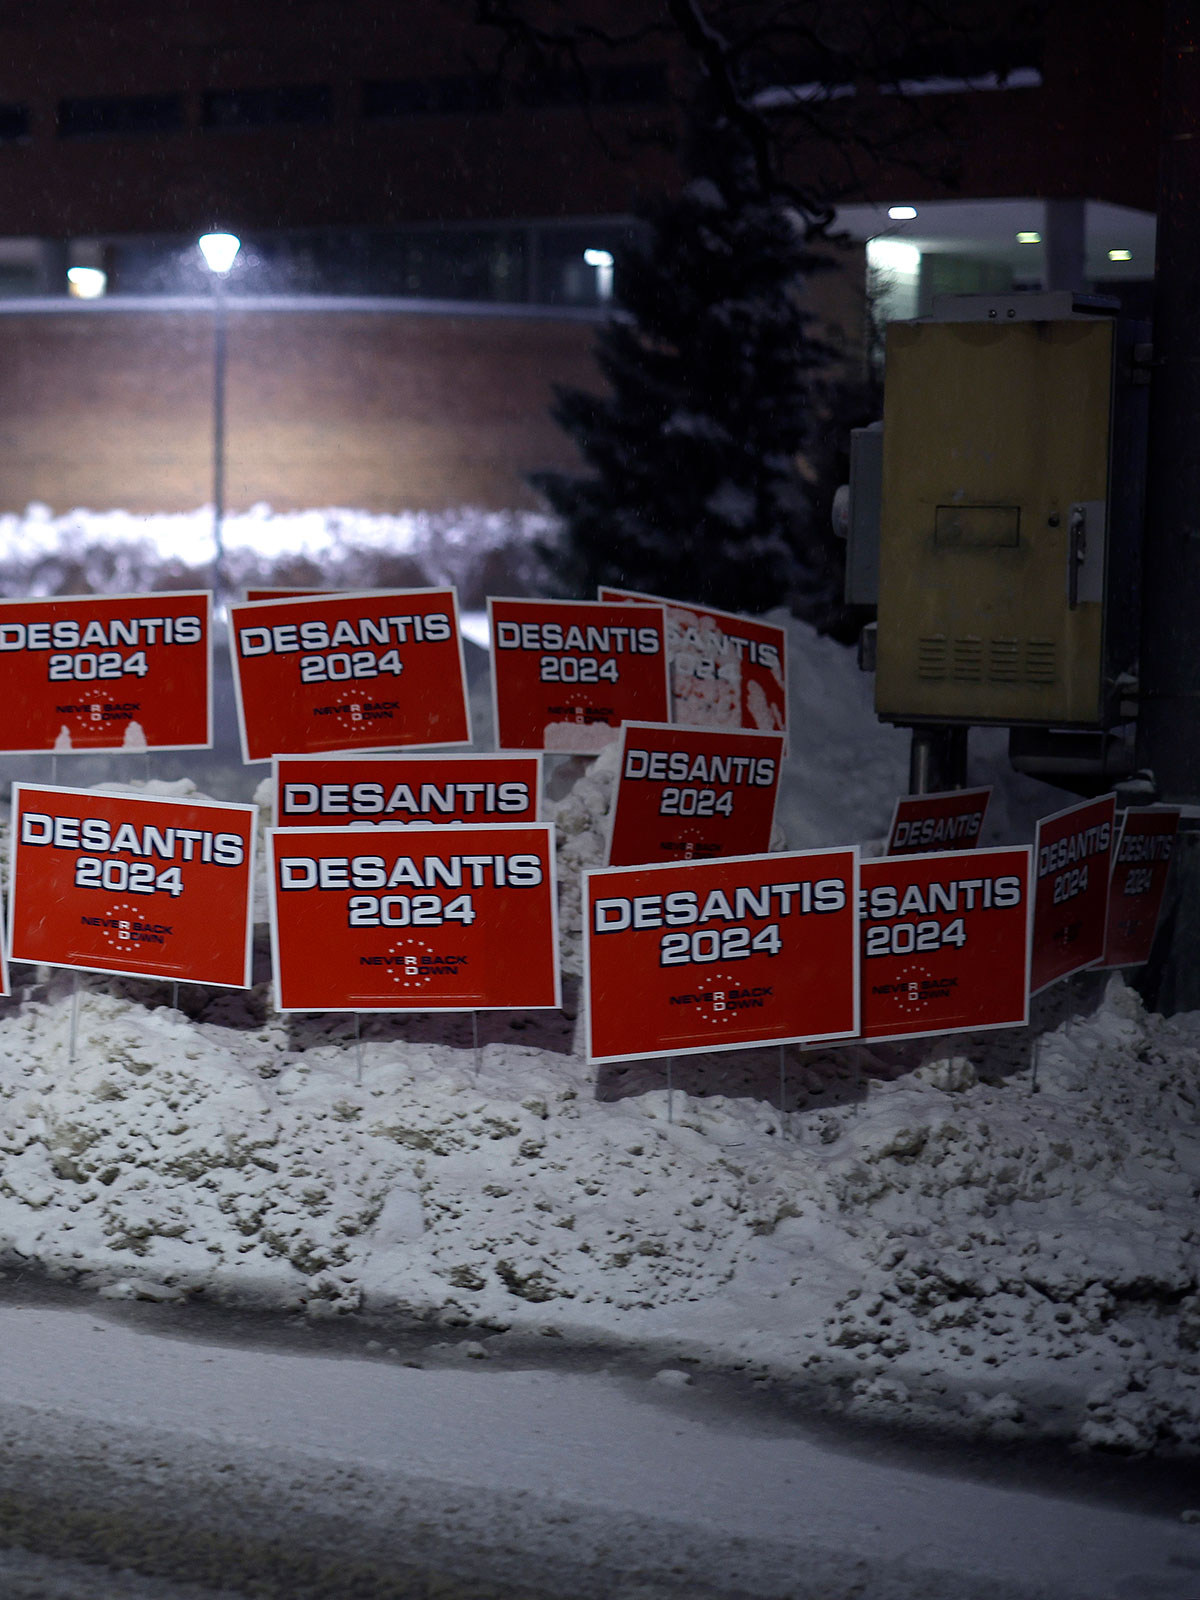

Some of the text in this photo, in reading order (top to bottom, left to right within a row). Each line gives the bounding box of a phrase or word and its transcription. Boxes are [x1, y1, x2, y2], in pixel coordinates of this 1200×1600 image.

[239, 613, 452, 659] DESANTIS
[497, 622, 660, 655] DESANTIS
[48, 651, 148, 682] 2024
[299, 649, 403, 684] 2024
[539, 656, 619, 684] 2024
[56, 702, 140, 714] NEVER BACK
[314, 701, 400, 716] NEVER BACK
[625, 749, 775, 787] DESANTIS
[283, 781, 529, 815] DESANTIS
[660, 787, 733, 818] 2024
[21, 812, 245, 867] DESANTIS
[894, 812, 981, 848] DESANTIS
[1038, 822, 1110, 878] DESANTIS
[1118, 834, 1173, 862] DESANTIS
[74, 857, 184, 898] 2024
[280, 854, 543, 892] DESANTIS
[1054, 865, 1088, 904] 2024
[348, 895, 476, 928] 2024
[594, 878, 846, 936] DESANTIS
[859, 876, 1021, 921] SANTIS
[81, 916, 172, 936] NEVER BACK
[118, 931, 164, 944] DOWN
[866, 919, 966, 956] 2024
[360, 956, 467, 966] NEVER BACK
[659, 924, 782, 965] 2024
[404, 965, 457, 975] DOWN
[872, 977, 957, 996] NEVER BACK
[670, 987, 772, 1006] NEVER BACK
[713, 997, 764, 1011] DOWN
